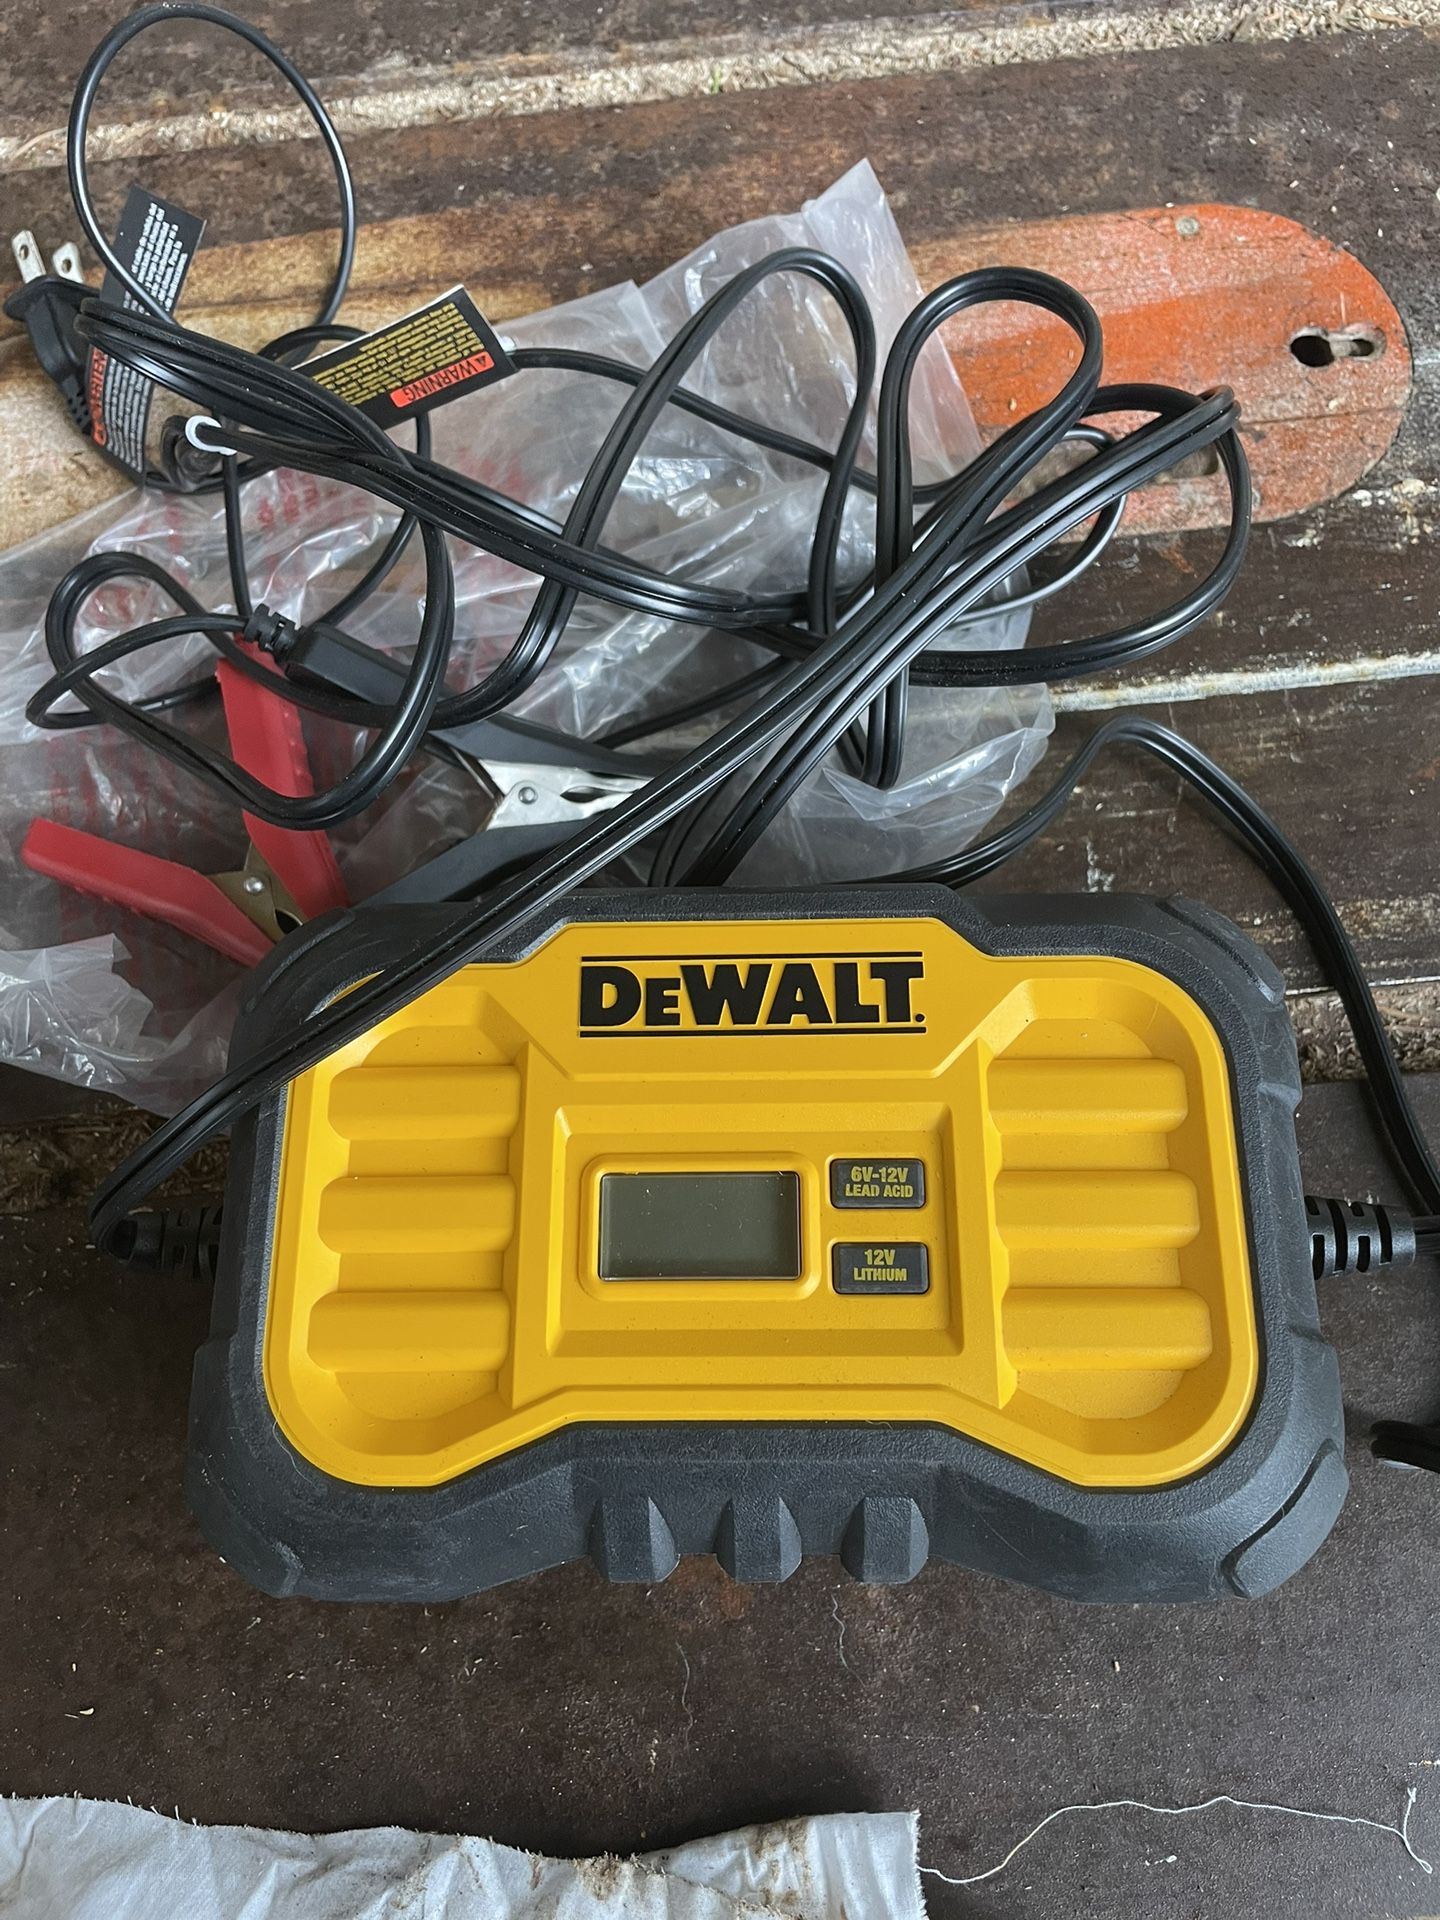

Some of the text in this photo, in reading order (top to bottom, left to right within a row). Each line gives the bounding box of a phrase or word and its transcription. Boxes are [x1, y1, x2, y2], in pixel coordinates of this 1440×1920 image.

[403, 359, 479, 402] WARNING
[850, 1166, 909, 1183] 6V-12V
[845, 1184, 913, 1198] LEAD ACID
[864, 1249, 895, 1266] 12V
[853, 1268, 907, 1282] LITHIUM
